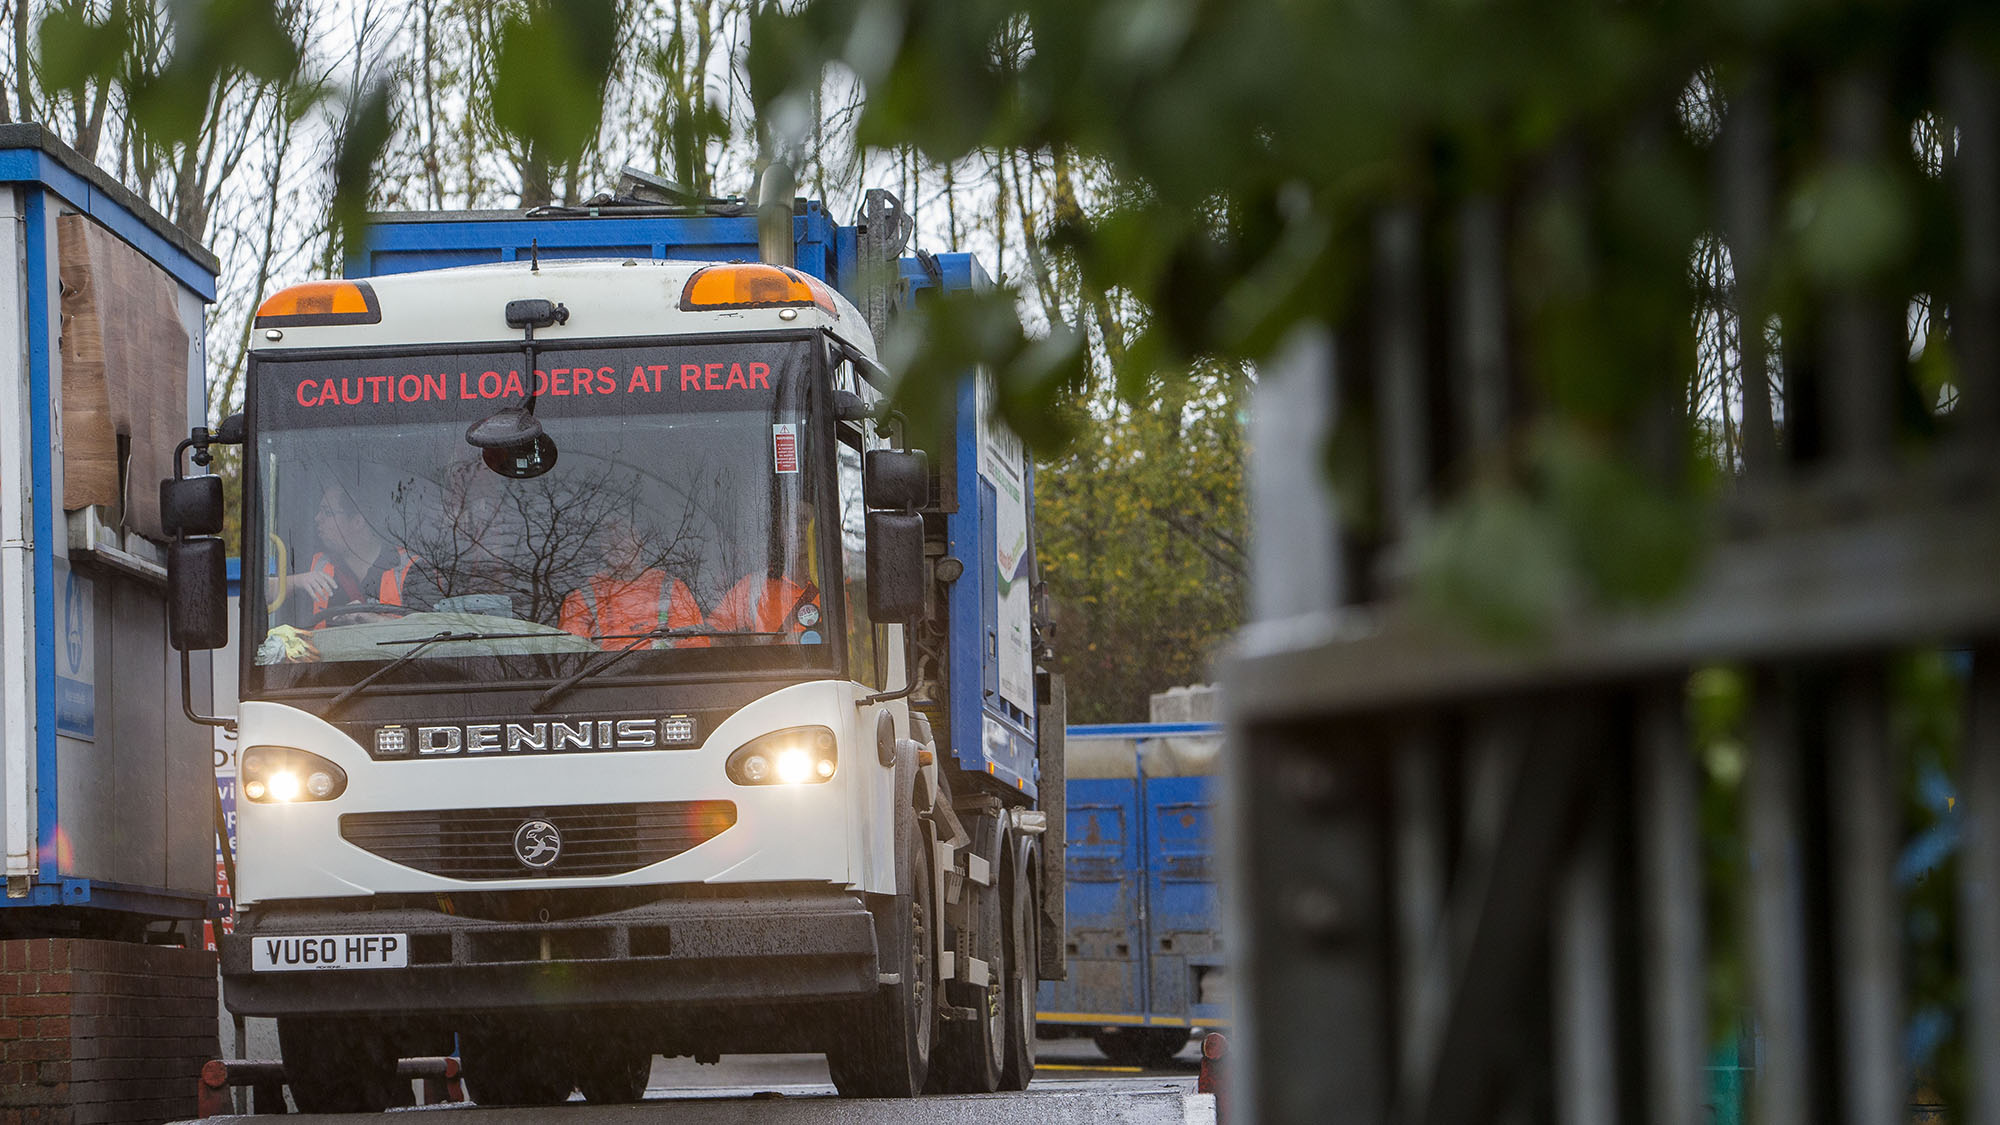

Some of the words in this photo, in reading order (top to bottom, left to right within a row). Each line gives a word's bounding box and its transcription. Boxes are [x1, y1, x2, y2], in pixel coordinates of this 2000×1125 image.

[296, 373, 447, 408] CAUTION
[460, 366, 617, 400] LOADERS
[627, 365, 669, 393] AT
[680, 362, 771, 392] REAR
[418, 719, 657, 755] DENNIS
[266, 938, 337, 965] VU60
[345, 937, 398, 963] HFP
